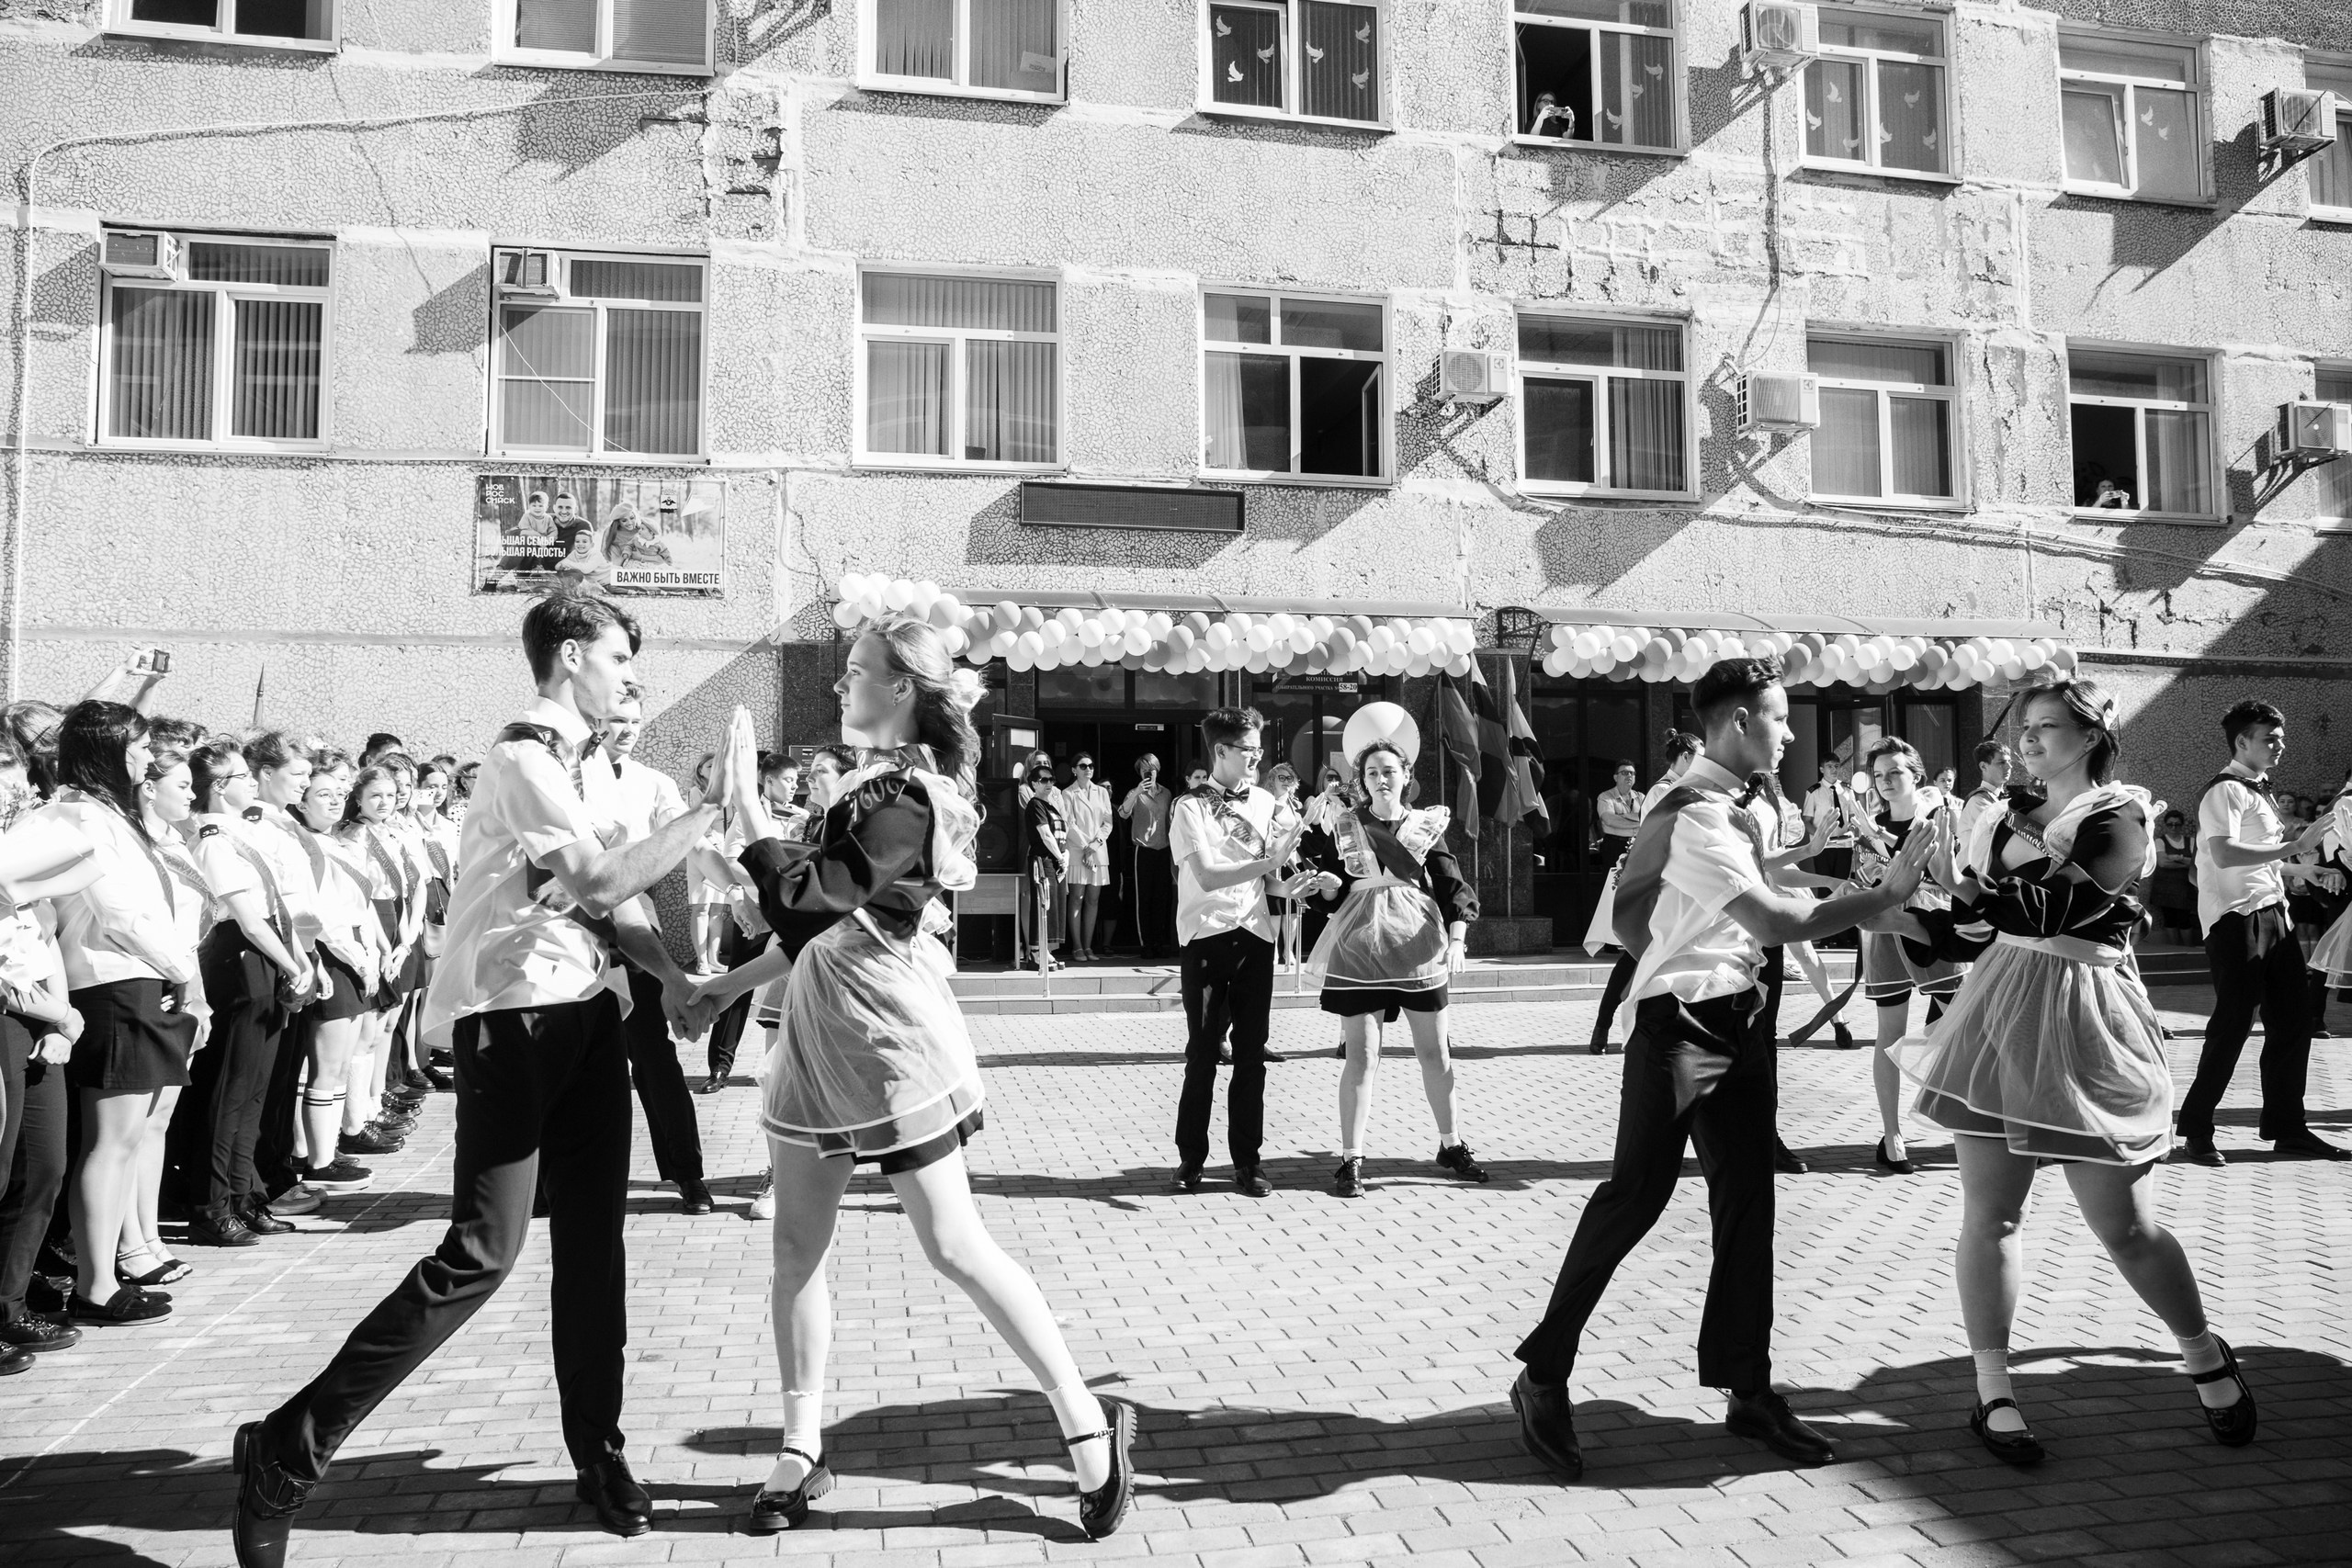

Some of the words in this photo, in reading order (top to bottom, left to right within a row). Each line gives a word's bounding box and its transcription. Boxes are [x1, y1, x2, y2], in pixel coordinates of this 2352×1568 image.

[526, 536, 555, 547] СЕМЬЯ
[526, 547, 567, 558] РАДОСТЬ!
[616, 571, 651, 583] ВАЖНО
[653, 572, 681, 584] БЫТЬ
[683, 572, 719, 585] ВМЕСТЕ
